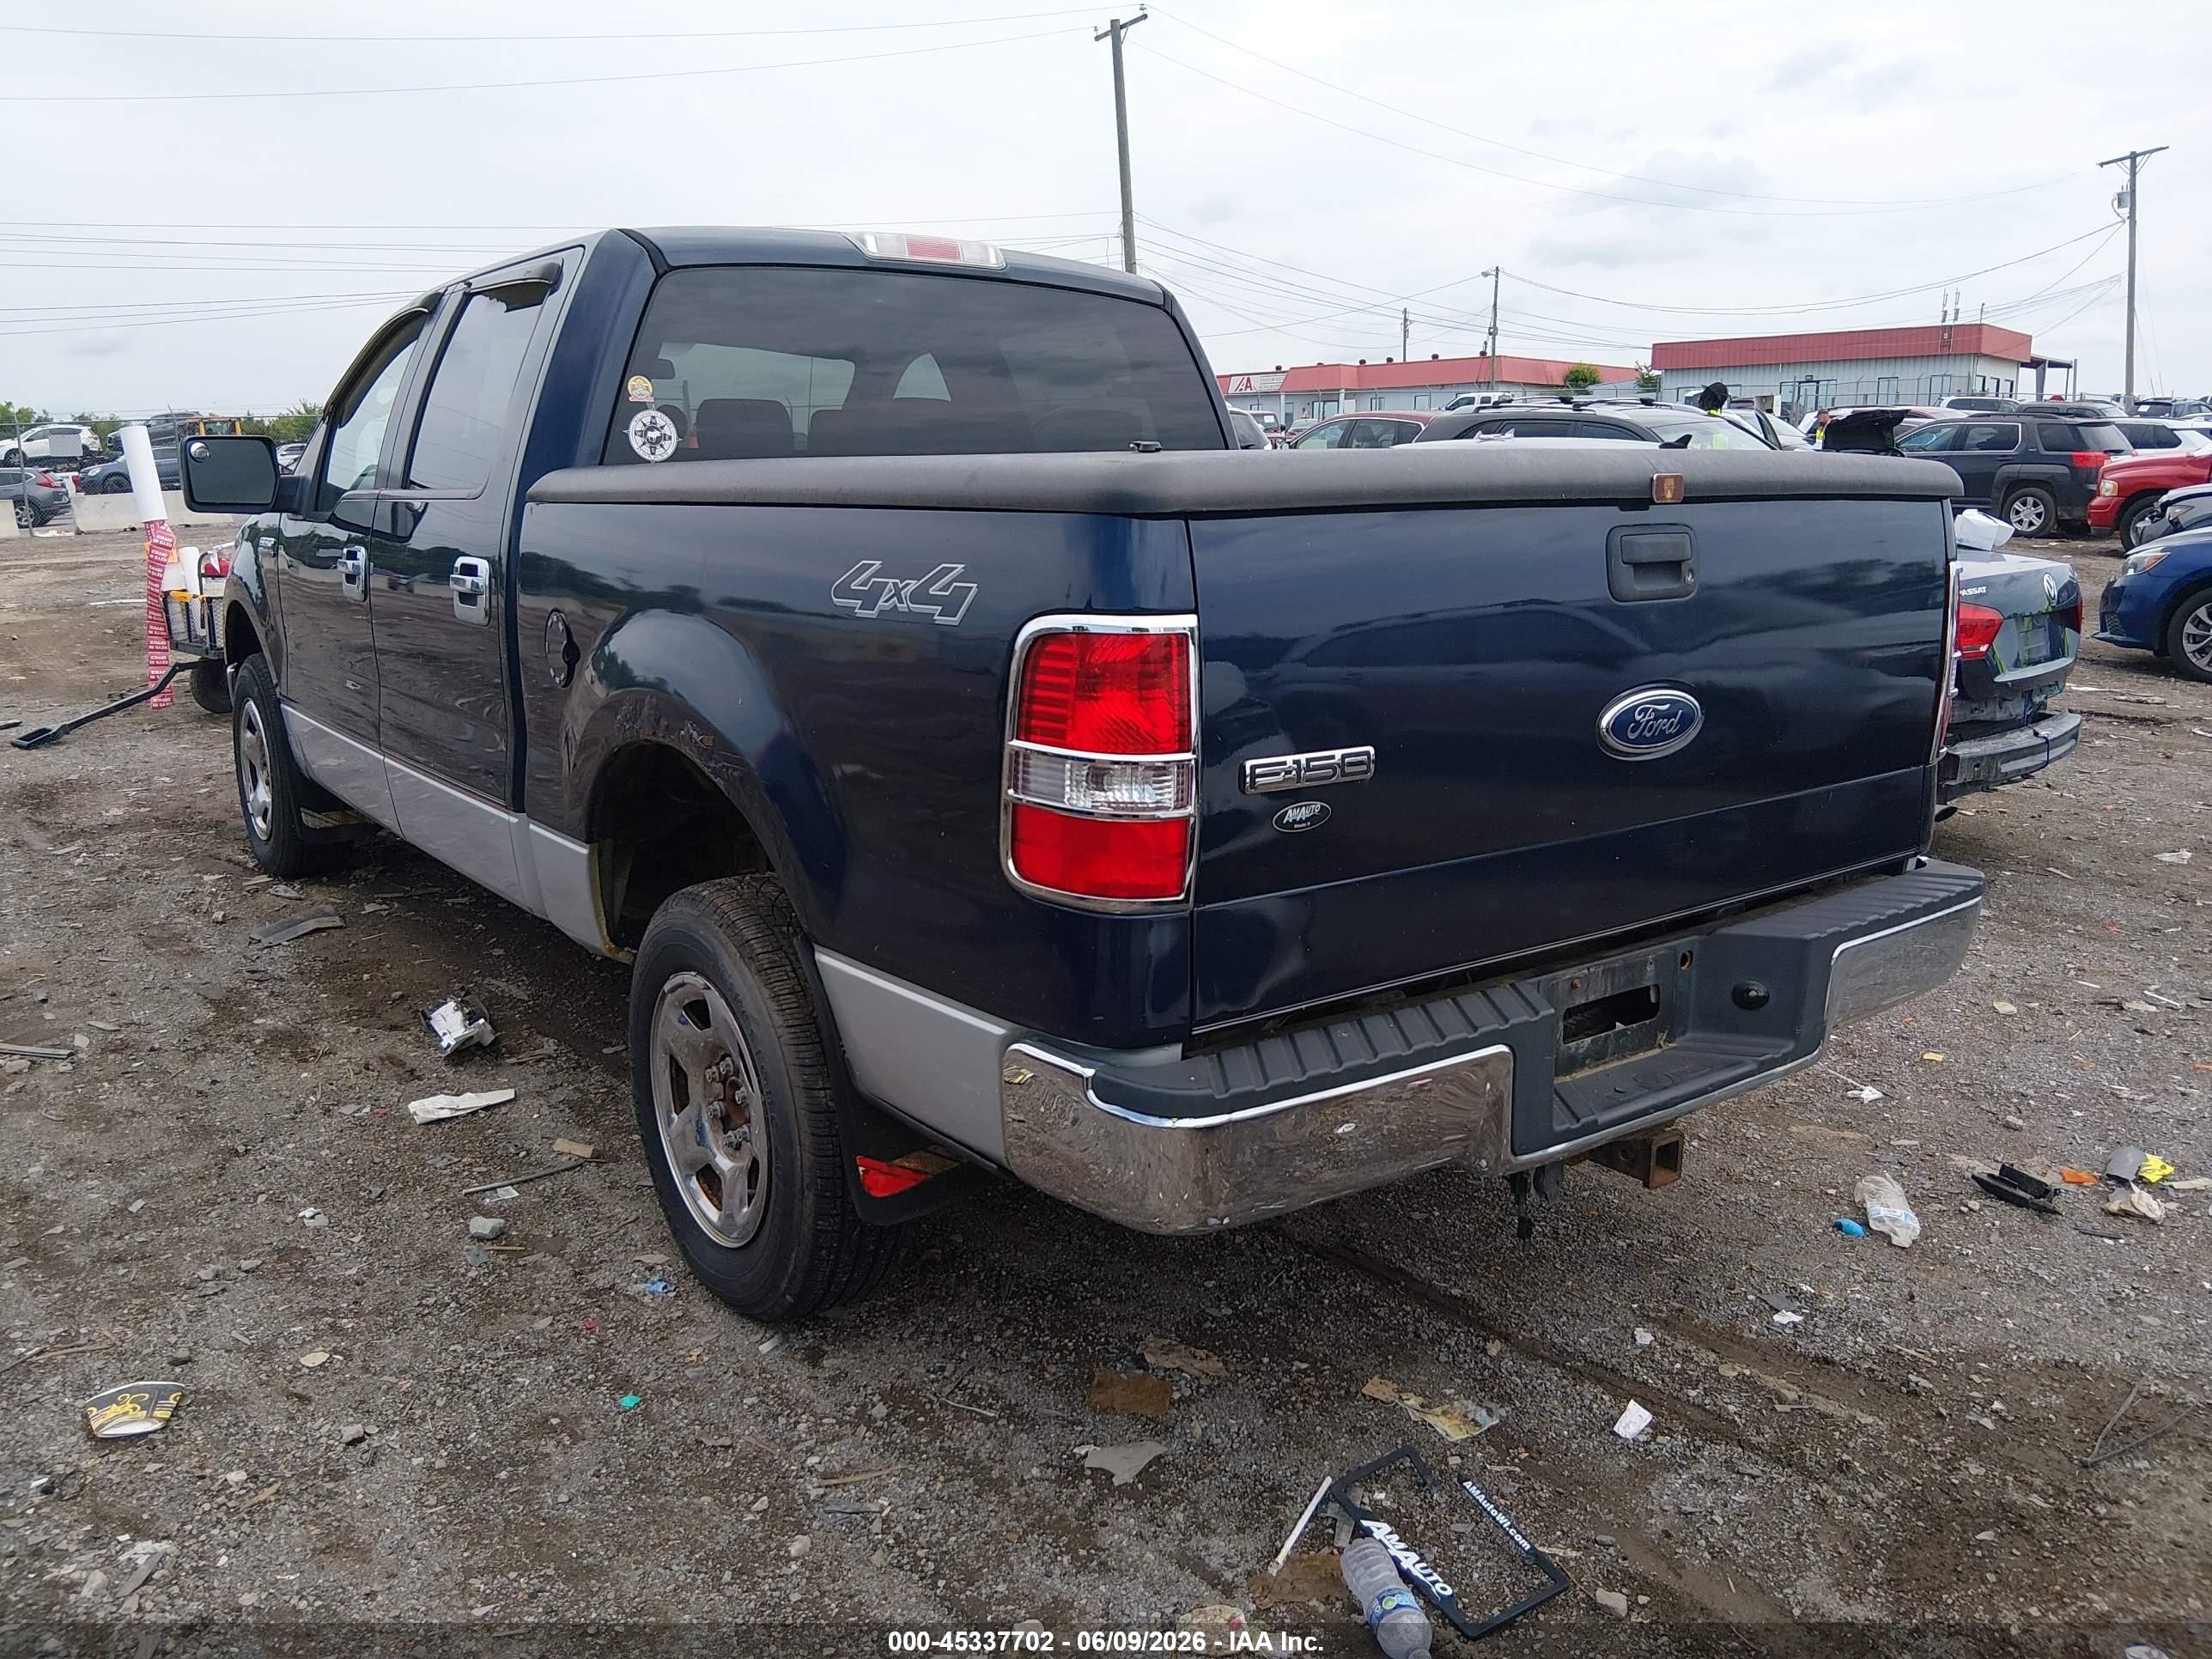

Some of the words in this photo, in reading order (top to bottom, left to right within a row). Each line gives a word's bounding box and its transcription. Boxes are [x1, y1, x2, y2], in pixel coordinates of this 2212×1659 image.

[831, 560, 979, 626] 4x4
[1627, 703, 1683, 739] Ford
[1249, 750, 1372, 790] F-150
[1462, 1480, 1532, 1551] AMAutoWI.com
